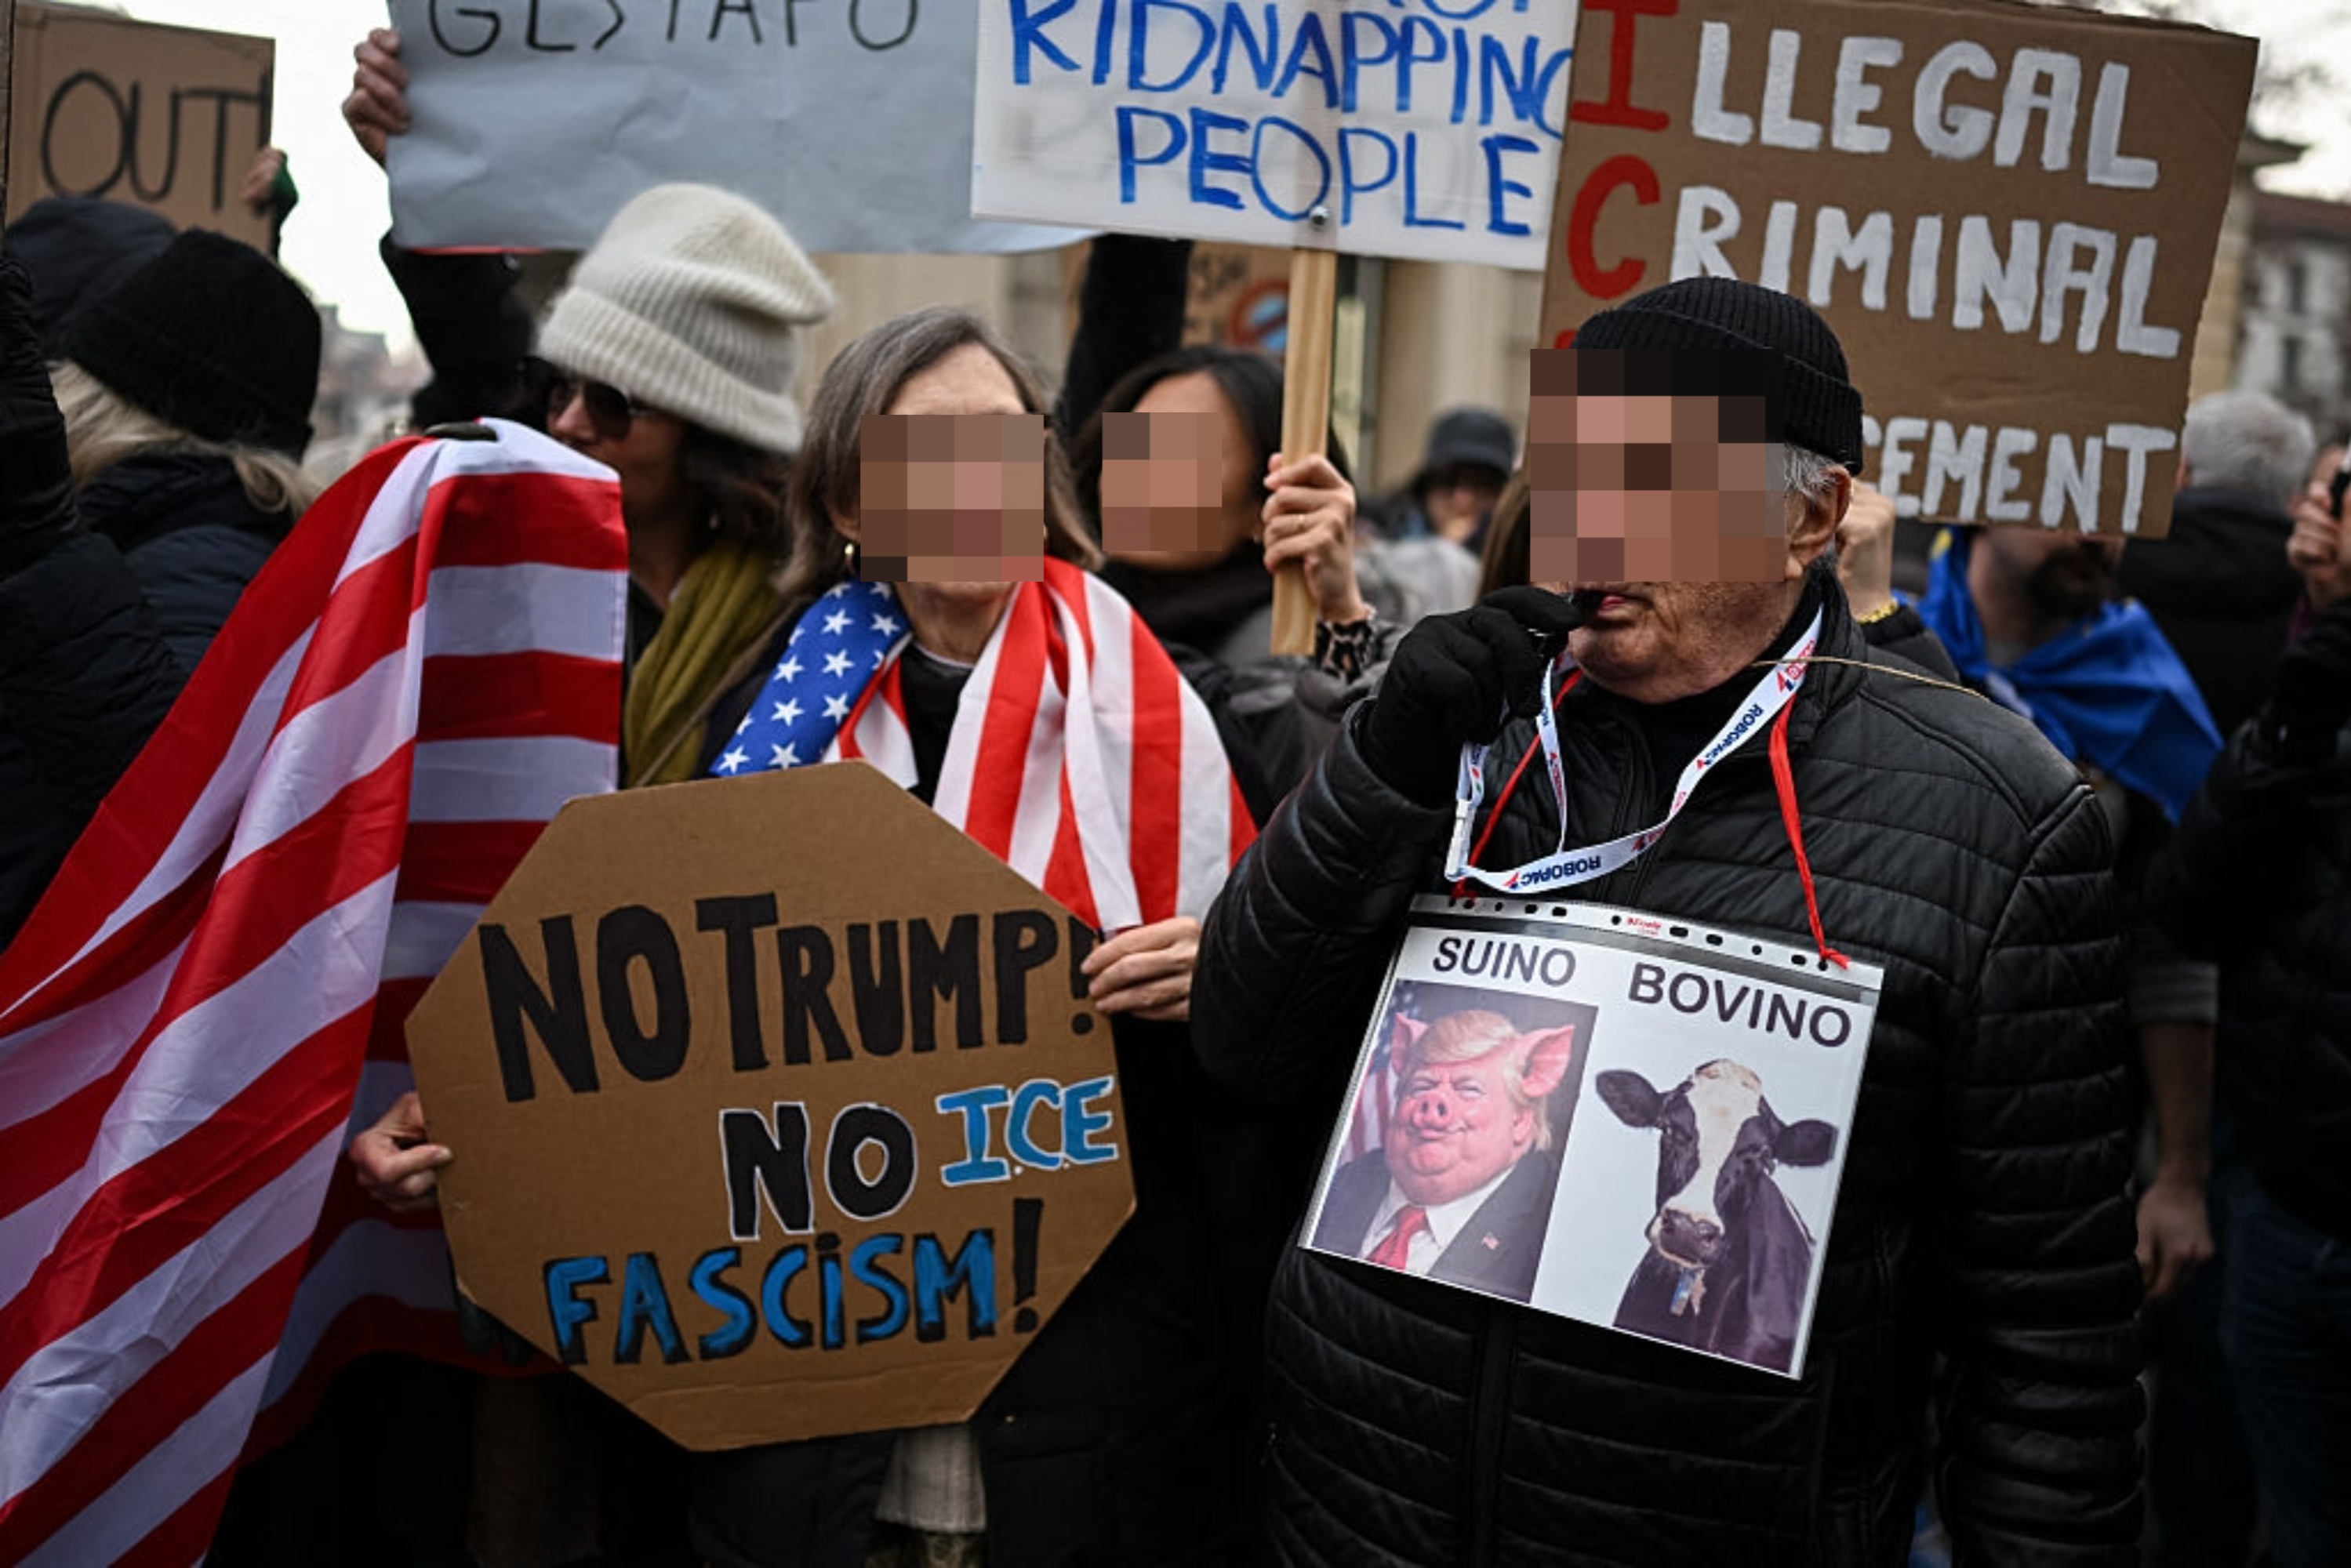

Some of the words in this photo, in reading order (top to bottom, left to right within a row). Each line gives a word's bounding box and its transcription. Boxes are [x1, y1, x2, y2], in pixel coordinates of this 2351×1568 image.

[1115, 105, 1540, 236] PEOPLE
[478, 904, 691, 1103] NO
[696, 892, 1095, 1073] TRUMP!
[1433, 936, 1577, 987] SUINO
[1628, 962, 1851, 1048] BOVINO
[718, 1101, 918, 1241] NO
